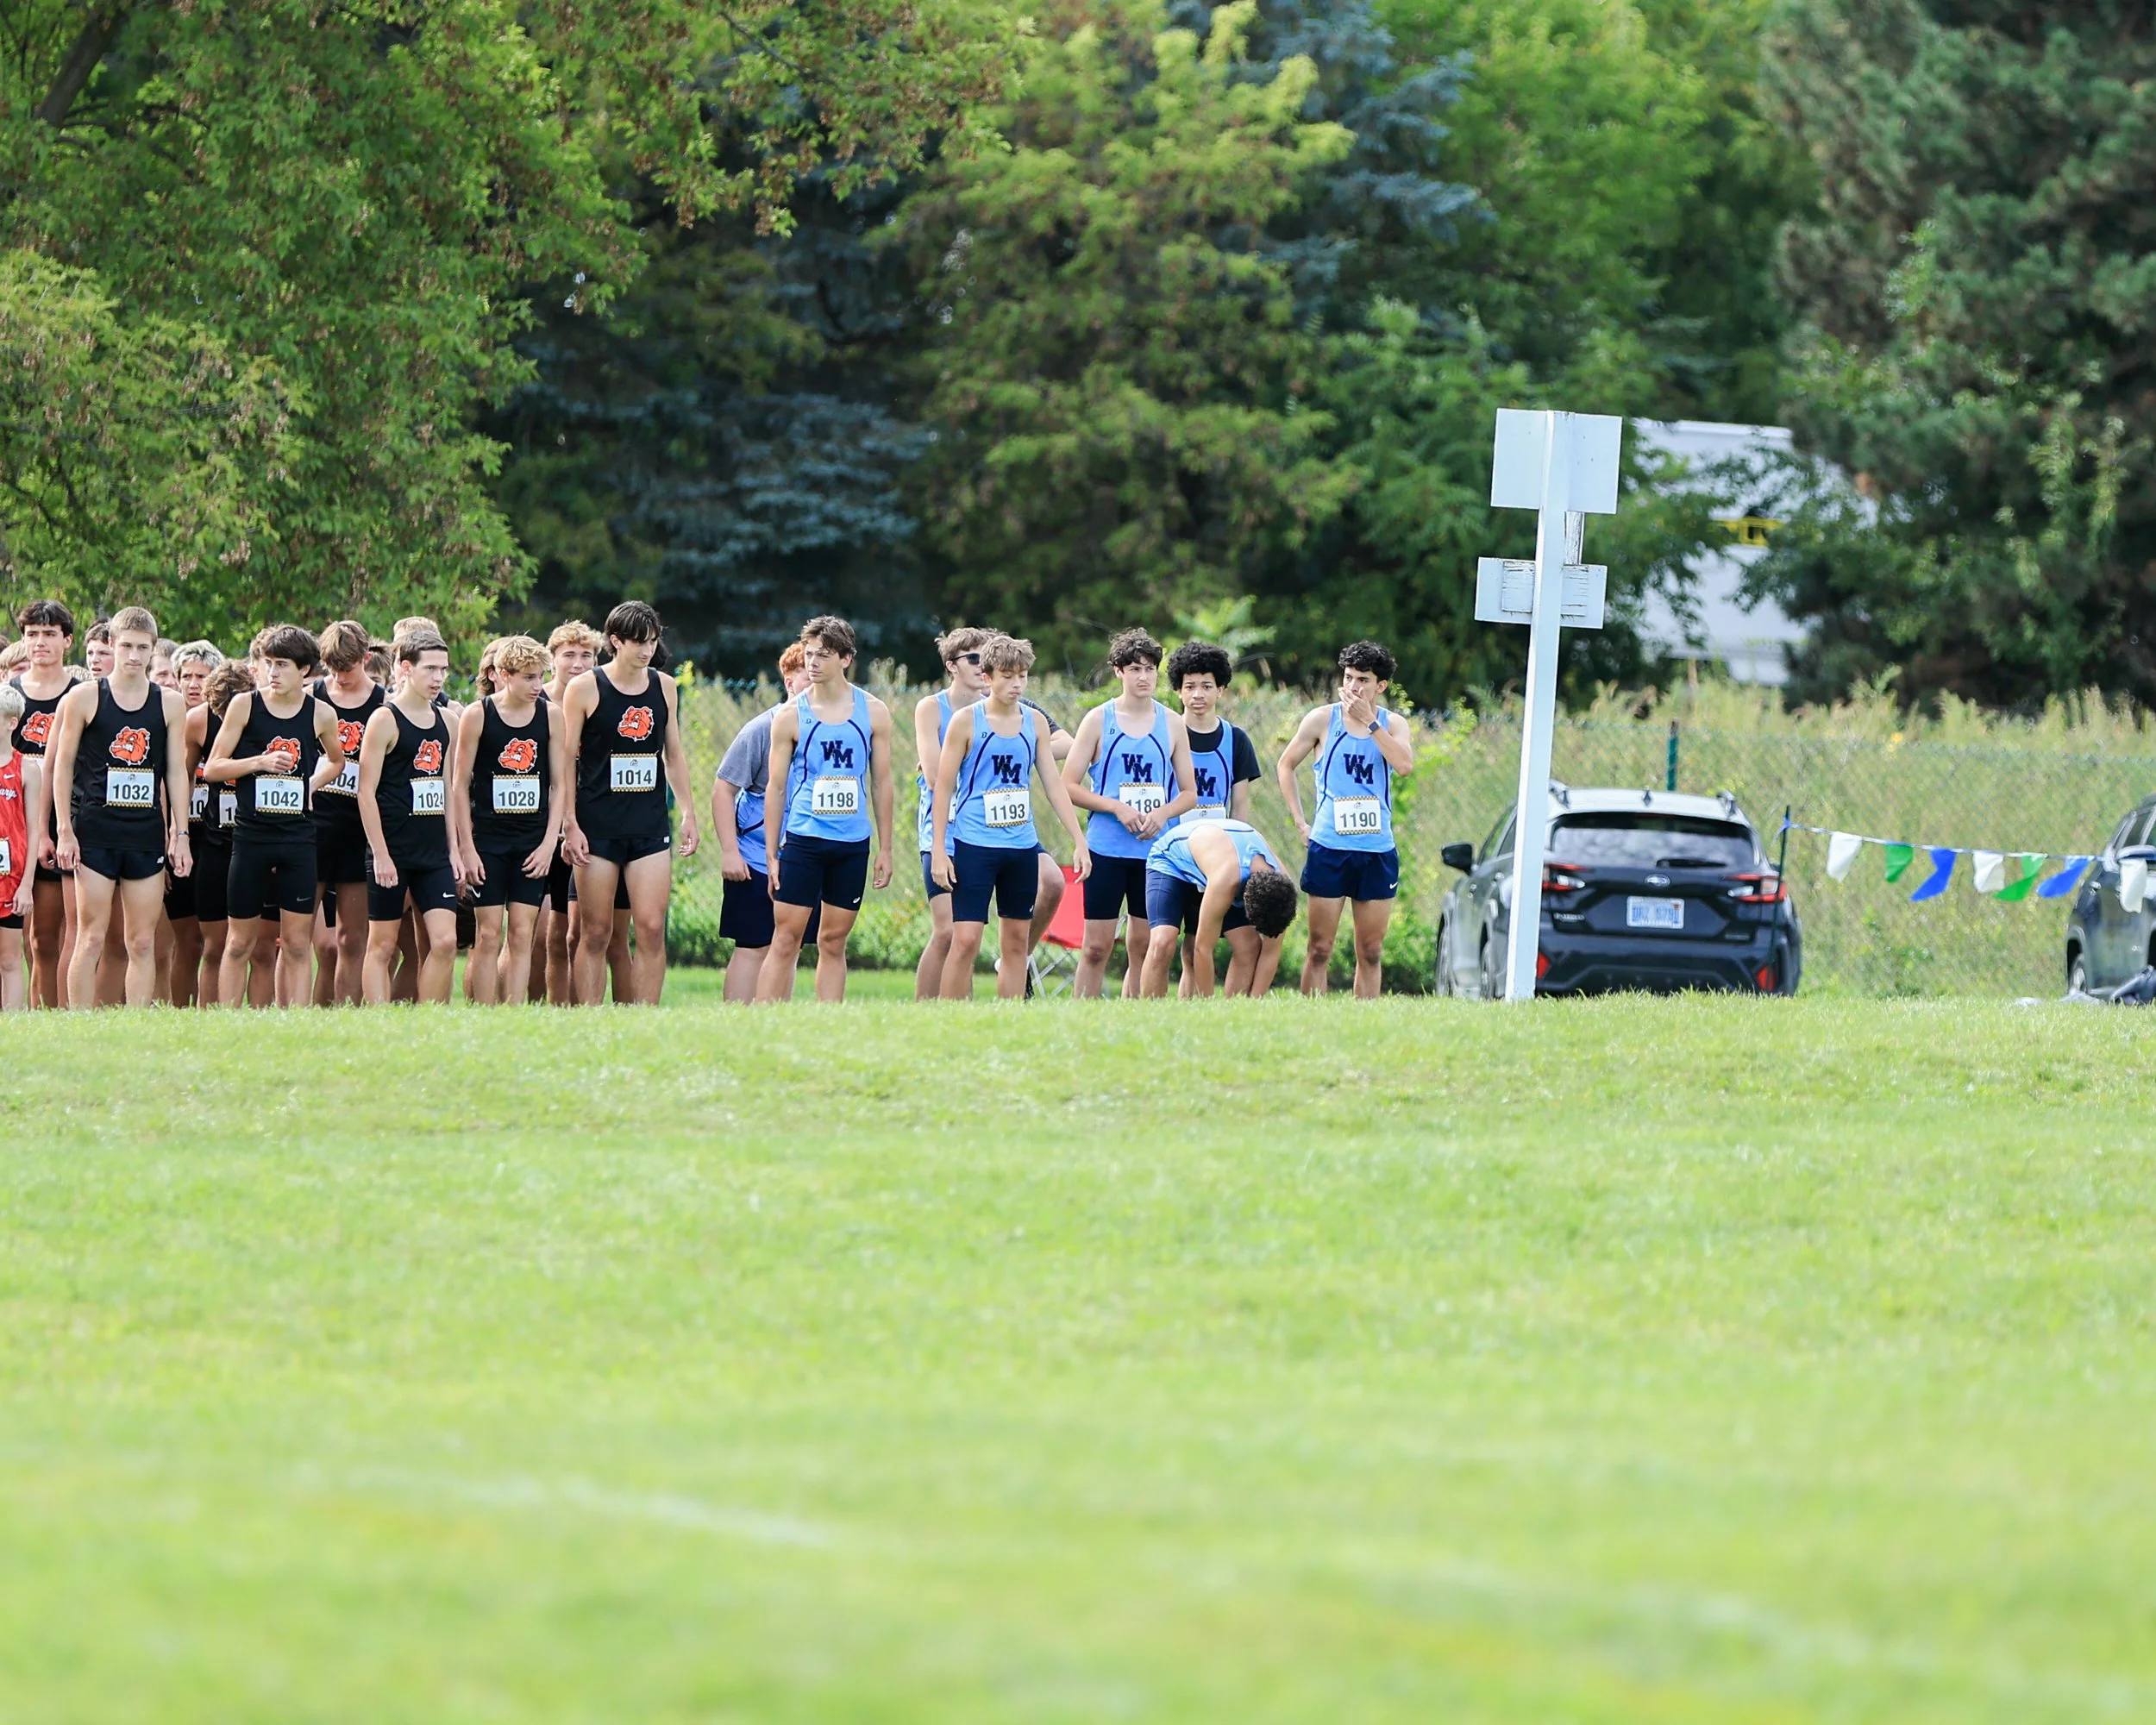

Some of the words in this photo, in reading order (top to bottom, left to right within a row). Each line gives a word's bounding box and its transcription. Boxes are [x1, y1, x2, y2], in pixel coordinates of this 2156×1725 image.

[820, 740, 854, 768] WM
[992, 755, 1022, 784] WM
[1122, 753, 1153, 783] WM
[1343, 753, 1374, 784] WM
[617, 769, 653, 785] 1014
[112, 784, 150, 800] 1032
[261, 790, 299, 807] 1042
[498, 791, 536, 806] 1028
[818, 793, 854, 807] 1198
[991, 804, 1025, 820] 1193
[1340, 812, 1377, 828] 1190
